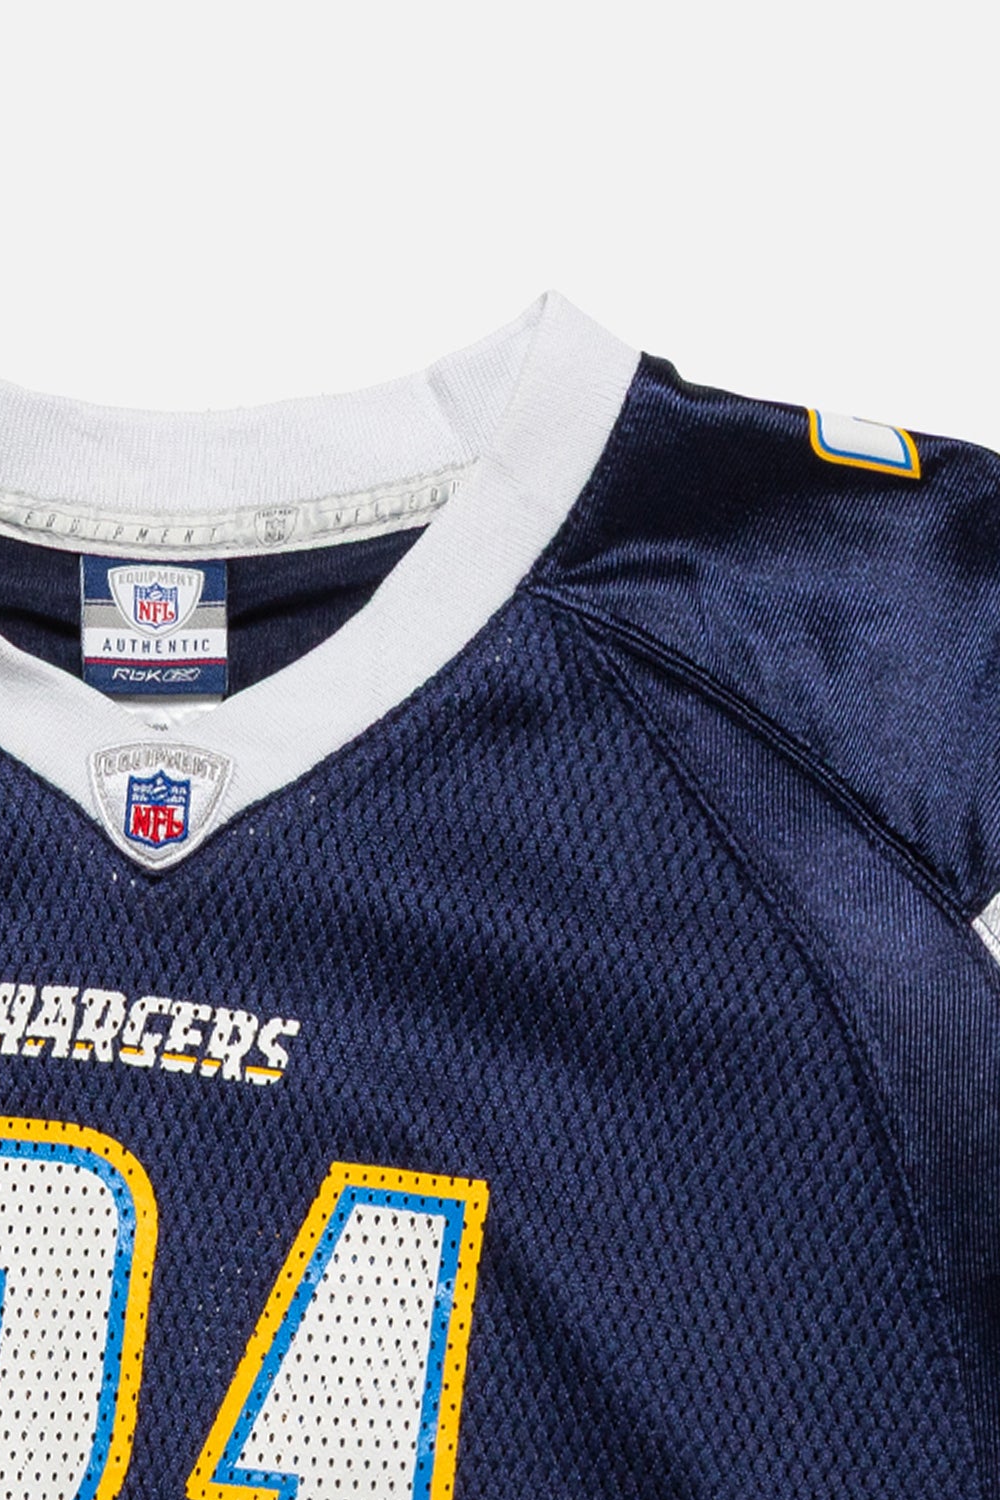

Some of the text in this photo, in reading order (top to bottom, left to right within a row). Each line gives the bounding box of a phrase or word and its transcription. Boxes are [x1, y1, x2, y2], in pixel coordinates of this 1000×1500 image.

[333, 503, 380, 523] NFL
[24, 511, 217, 543] EQUIPMENT
[118, 572, 196, 588] EQUIPMENT
[137, 601, 176, 624] NFL
[103, 637, 211, 655] AUTHENTIC
[130, 805, 184, 843] NFL
